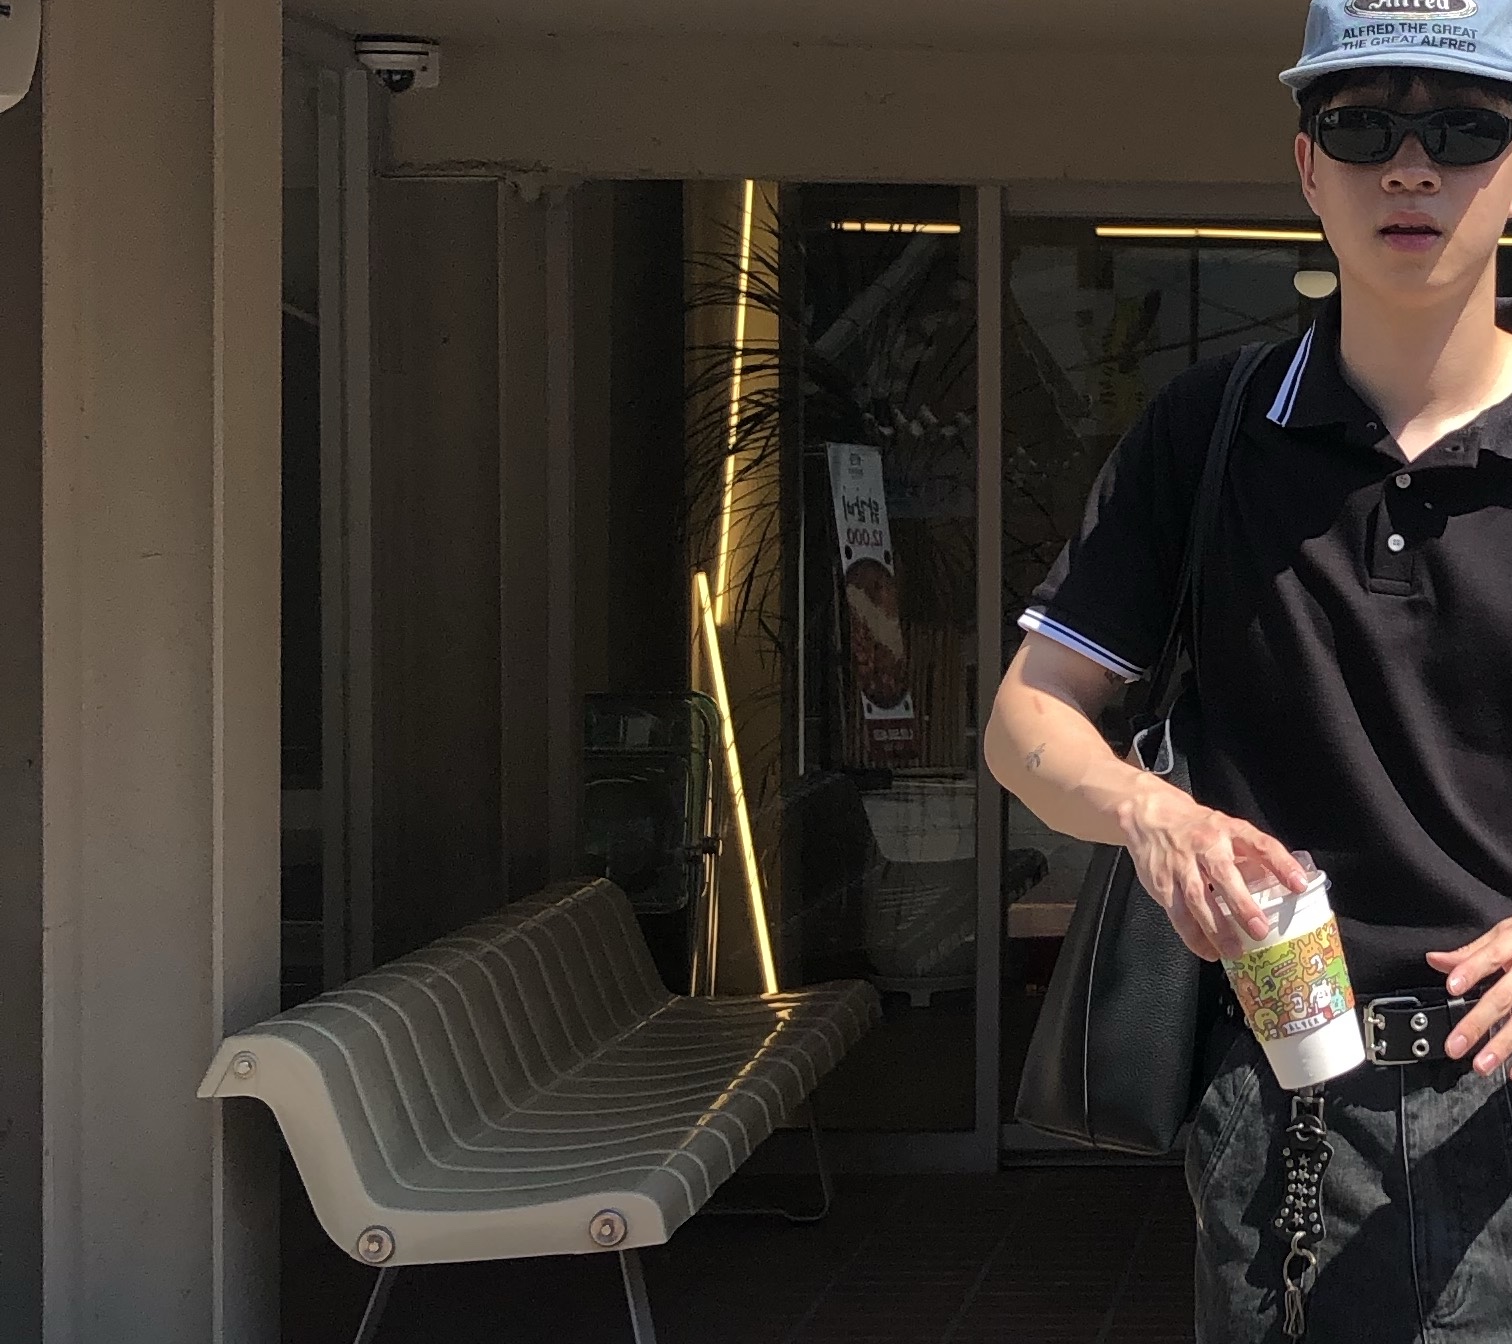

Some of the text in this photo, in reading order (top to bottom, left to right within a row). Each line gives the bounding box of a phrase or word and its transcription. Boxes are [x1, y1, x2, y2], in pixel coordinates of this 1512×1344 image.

[1342, 22, 1479, 40] ALFRED THE GREAT
[1342, 35, 1477, 53] THE GREAT ALFRED
